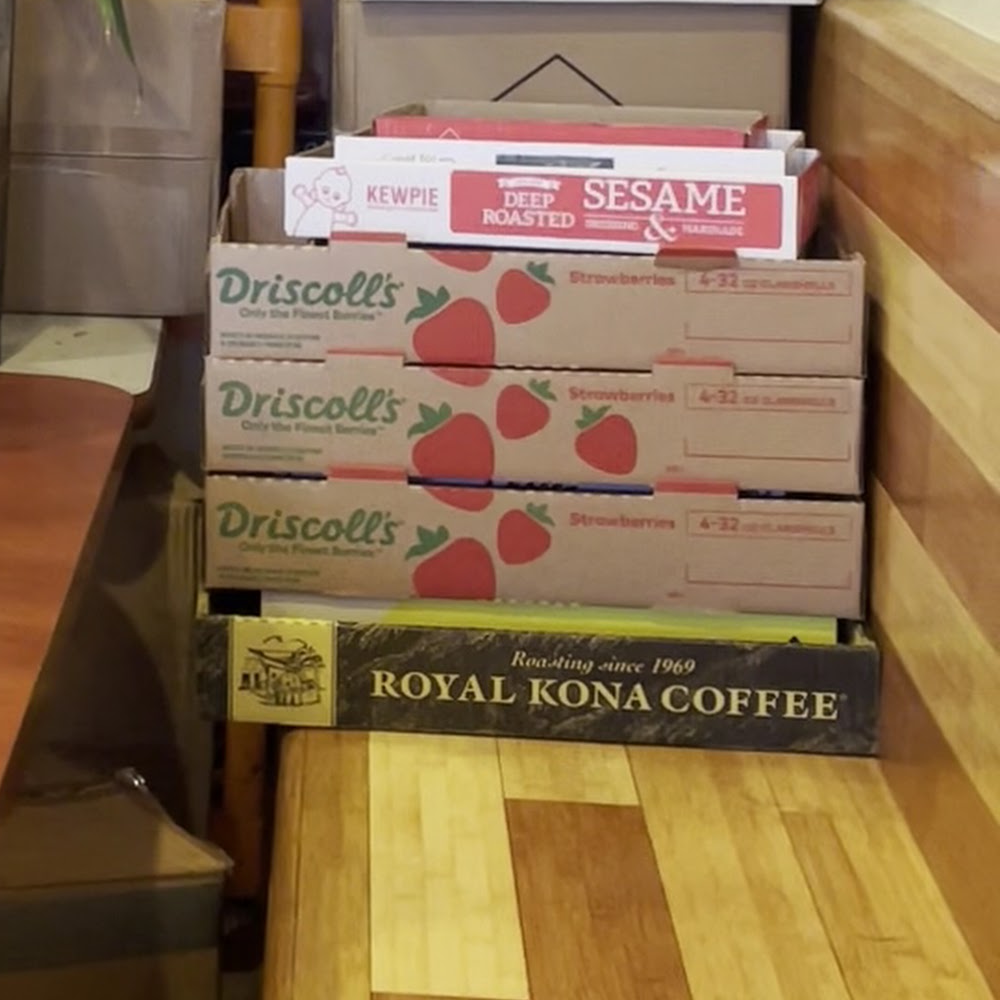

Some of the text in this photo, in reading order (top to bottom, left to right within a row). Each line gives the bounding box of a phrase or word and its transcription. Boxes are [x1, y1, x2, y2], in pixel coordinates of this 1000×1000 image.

[367, 185, 438, 206] KEWPIE
[503, 192, 555, 209] DEEP
[583, 178, 746, 216] SESAME
[482, 209, 575, 228] ROASTED
[644, 213, 678, 242] &
[216, 267, 401, 309] Driscoll's
[569, 270, 676, 287] Strawberries
[698, 272, 738, 288] 4-32
[239, 307, 267, 319] Only
[270, 308, 290, 318] the
[218, 381, 402, 424] Driscoll's
[569, 386, 675, 404] Strawberries
[216, 501, 401, 546] Driscoll's
[569, 512, 676, 530] Strawberries
[511, 650, 696, 676] Roasting since 1969
[370, 670, 839, 722] ROYAL KONA COFFEE
